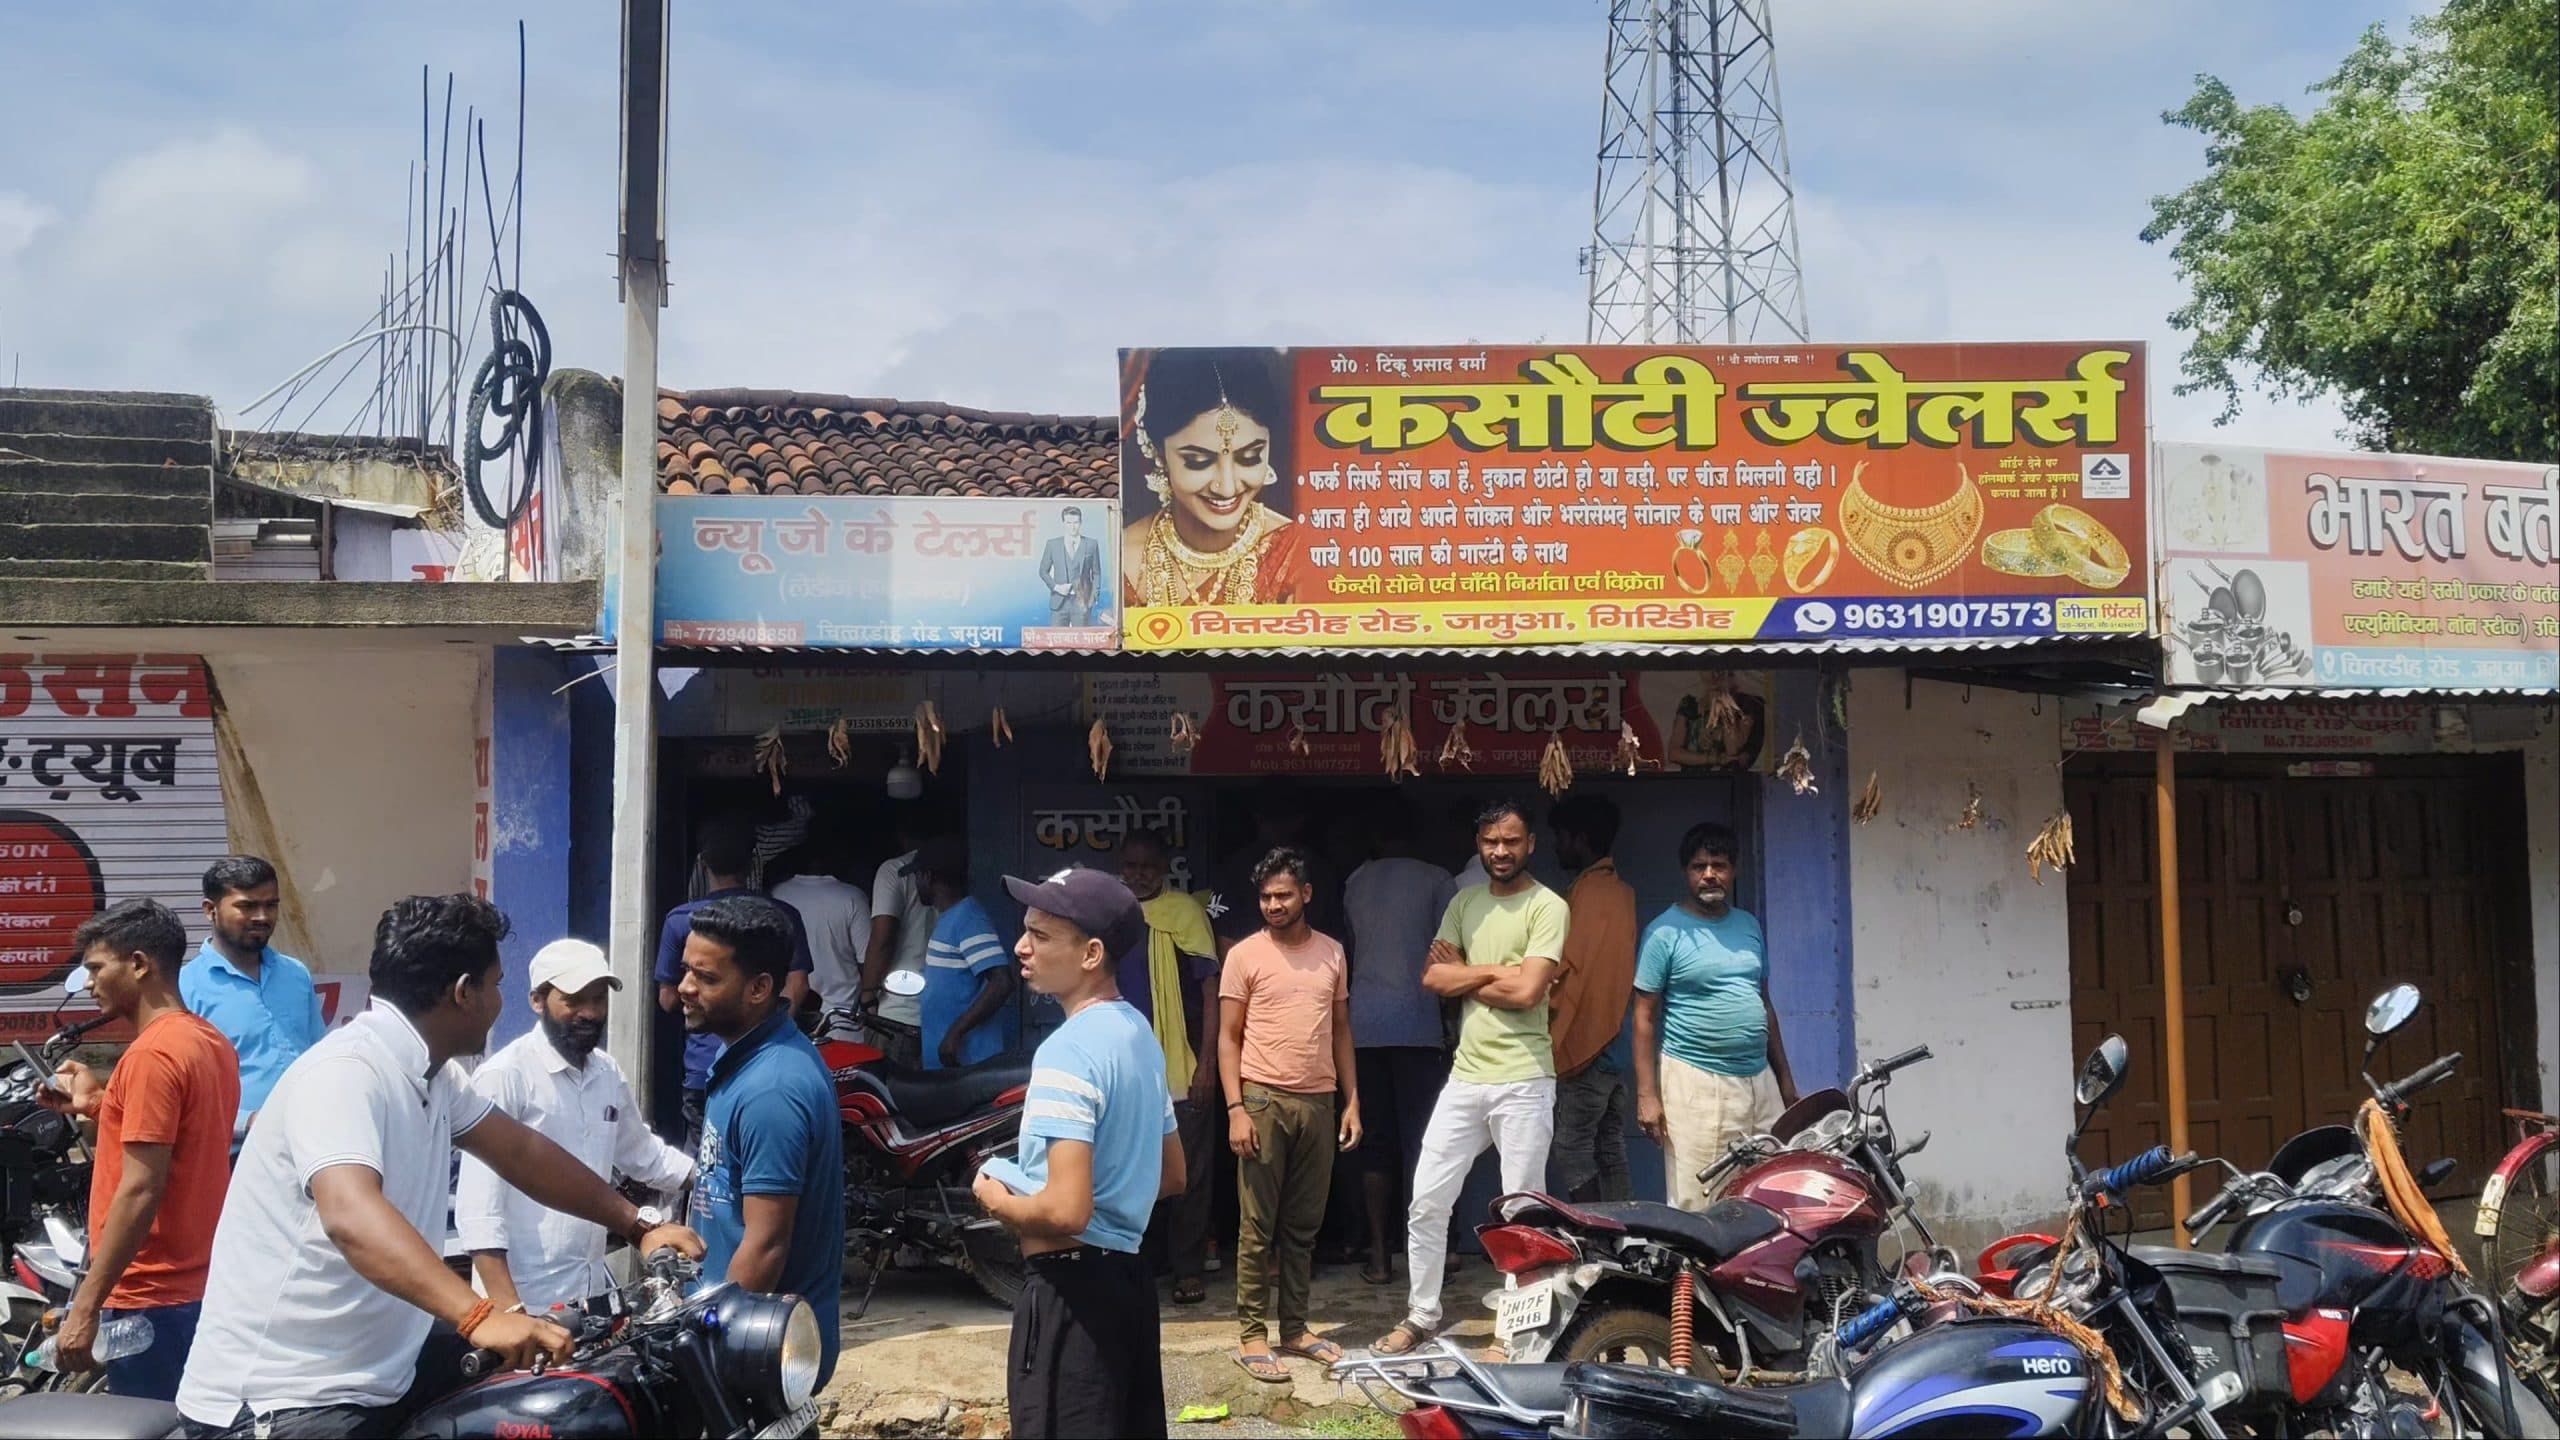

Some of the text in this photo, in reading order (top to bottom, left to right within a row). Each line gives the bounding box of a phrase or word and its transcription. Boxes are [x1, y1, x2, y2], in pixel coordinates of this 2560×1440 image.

[1376, 356, 1410, 378] टिंकू
[1413, 357, 1453, 374] प्रसाद
[1459, 355, 1487, 373] वर्मा
[1311, 350, 2132, 453] कसौटी ज्वेलर्स
[1310, 462, 1340, 490] फर्क
[1347, 462, 1381, 491] सिर्फ
[1429, 468, 1451, 490] का
[1483, 468, 1526, 498] दुकान
[1533, 461, 1568, 489] छोटी
[1575, 462, 1594, 491] हो
[1600, 466, 1619, 488] या
[1667, 466, 1690, 488] पर
[1696, 461, 1729, 489] चीज
[1793, 460, 1824, 489] वही
[1311, 506, 1345, 530] आज
[1353, 502, 1371, 533] ही
[1379, 502, 1412, 529] आये
[1419, 502, 1457, 529] अपने
[1464, 501, 1514, 528] लोकल
[1521, 500, 1553, 528] और
[1634, 500, 1682, 526] सोनार
[1689, 499, 1705, 525] के
[1711, 504, 1741, 526] पास
[1748, 499, 1781, 526] और
[1787, 499, 1823, 525] जेवर
[2304, 473, 2468, 563] भारत
[694, 506, 1037, 573] न्यू जे के टेलर्स
[1310, 537, 1569, 567] पाये 100 साल की गारंटी के साथ
[1328, 574, 1381, 597] फैन्सी
[1384, 572, 1425, 595] सोने
[1428, 571, 1456, 594] एवं
[1503, 570, 1572, 594] निर्माता
[1574, 570, 1602, 594] एवं
[1605, 569, 1666, 593] विक्रेता
[2351, 577, 2394, 600] हमारे
[2430, 577, 2464, 600] सभी
[2467, 582, 2508, 602] प्रकार
[2511, 580, 2528, 602] के
[1189, 607, 1352, 637] चित्तरडीह
[1585, 603, 1735, 634] गिरिडीह
[1843, 602, 2053, 630] 9631907573
[2062, 602, 2143, 619] गीता प्रिंटर्स
[2446, 613, 2478, 635] नॉन
[911, 619, 942, 643] रोड
[949, 625, 1004, 648] जमुआ
[1503, 1293, 1545, 1317] JH17F
[1506, 1311, 1541, 1330] 2918
[2022, 1358, 2071, 1374] Hero
[495, 1420, 552, 1439] ROYAL
